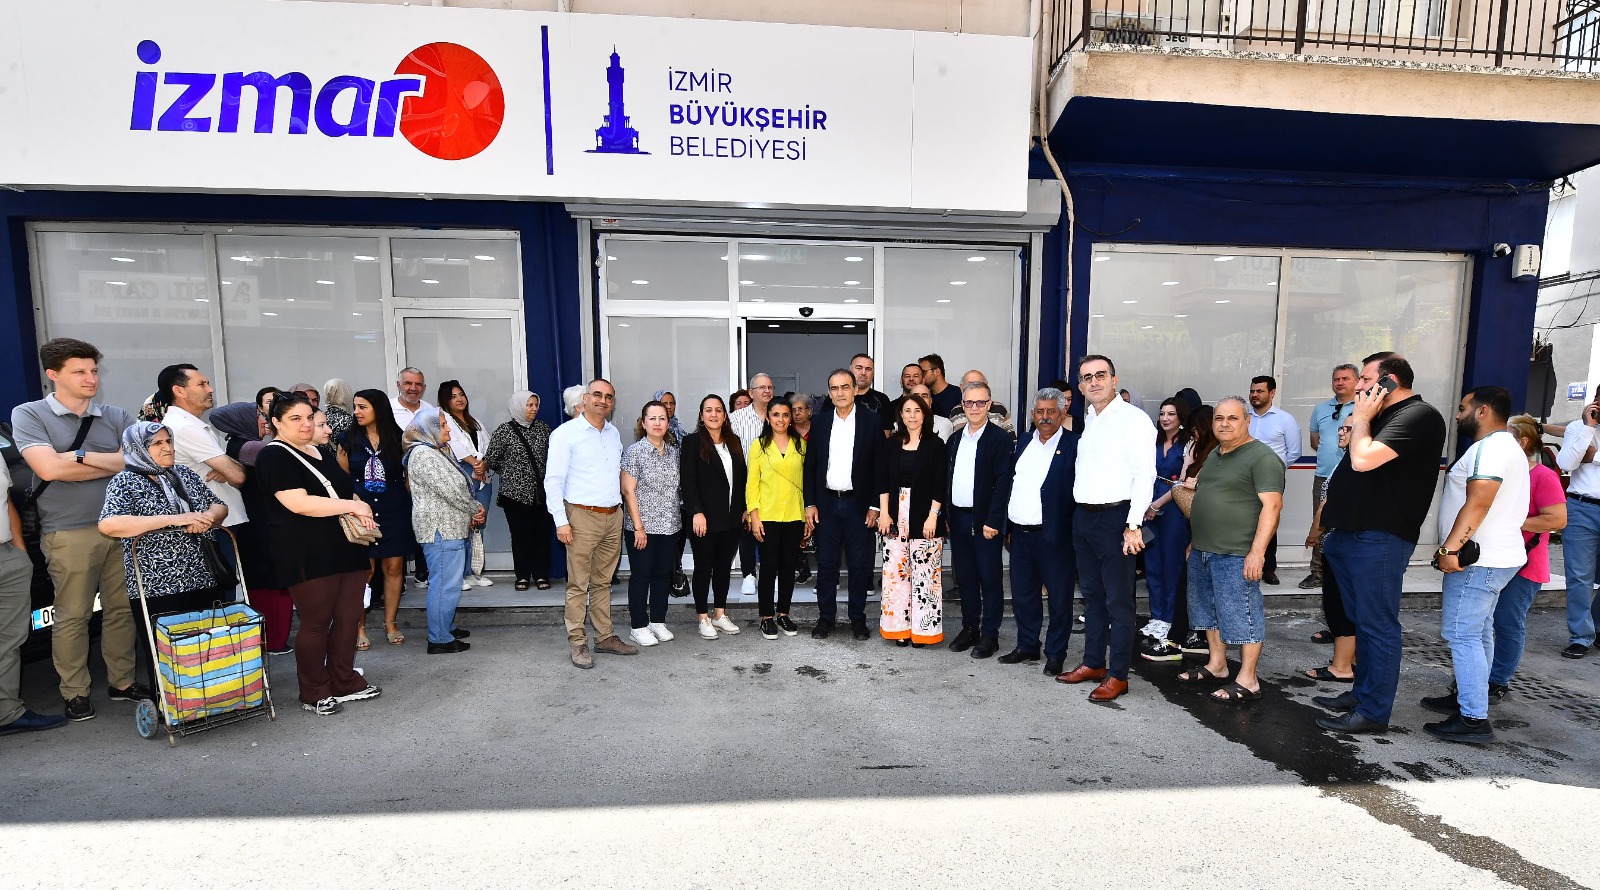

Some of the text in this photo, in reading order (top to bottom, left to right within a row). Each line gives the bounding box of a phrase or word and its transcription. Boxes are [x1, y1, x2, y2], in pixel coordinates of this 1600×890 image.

[131, 40, 421, 138] izmar
[669, 66, 732, 94] İZMİR
[669, 100, 828, 132] BÜYÜKŞEHİR
[670, 135, 807, 161] BELEDİYESİ
